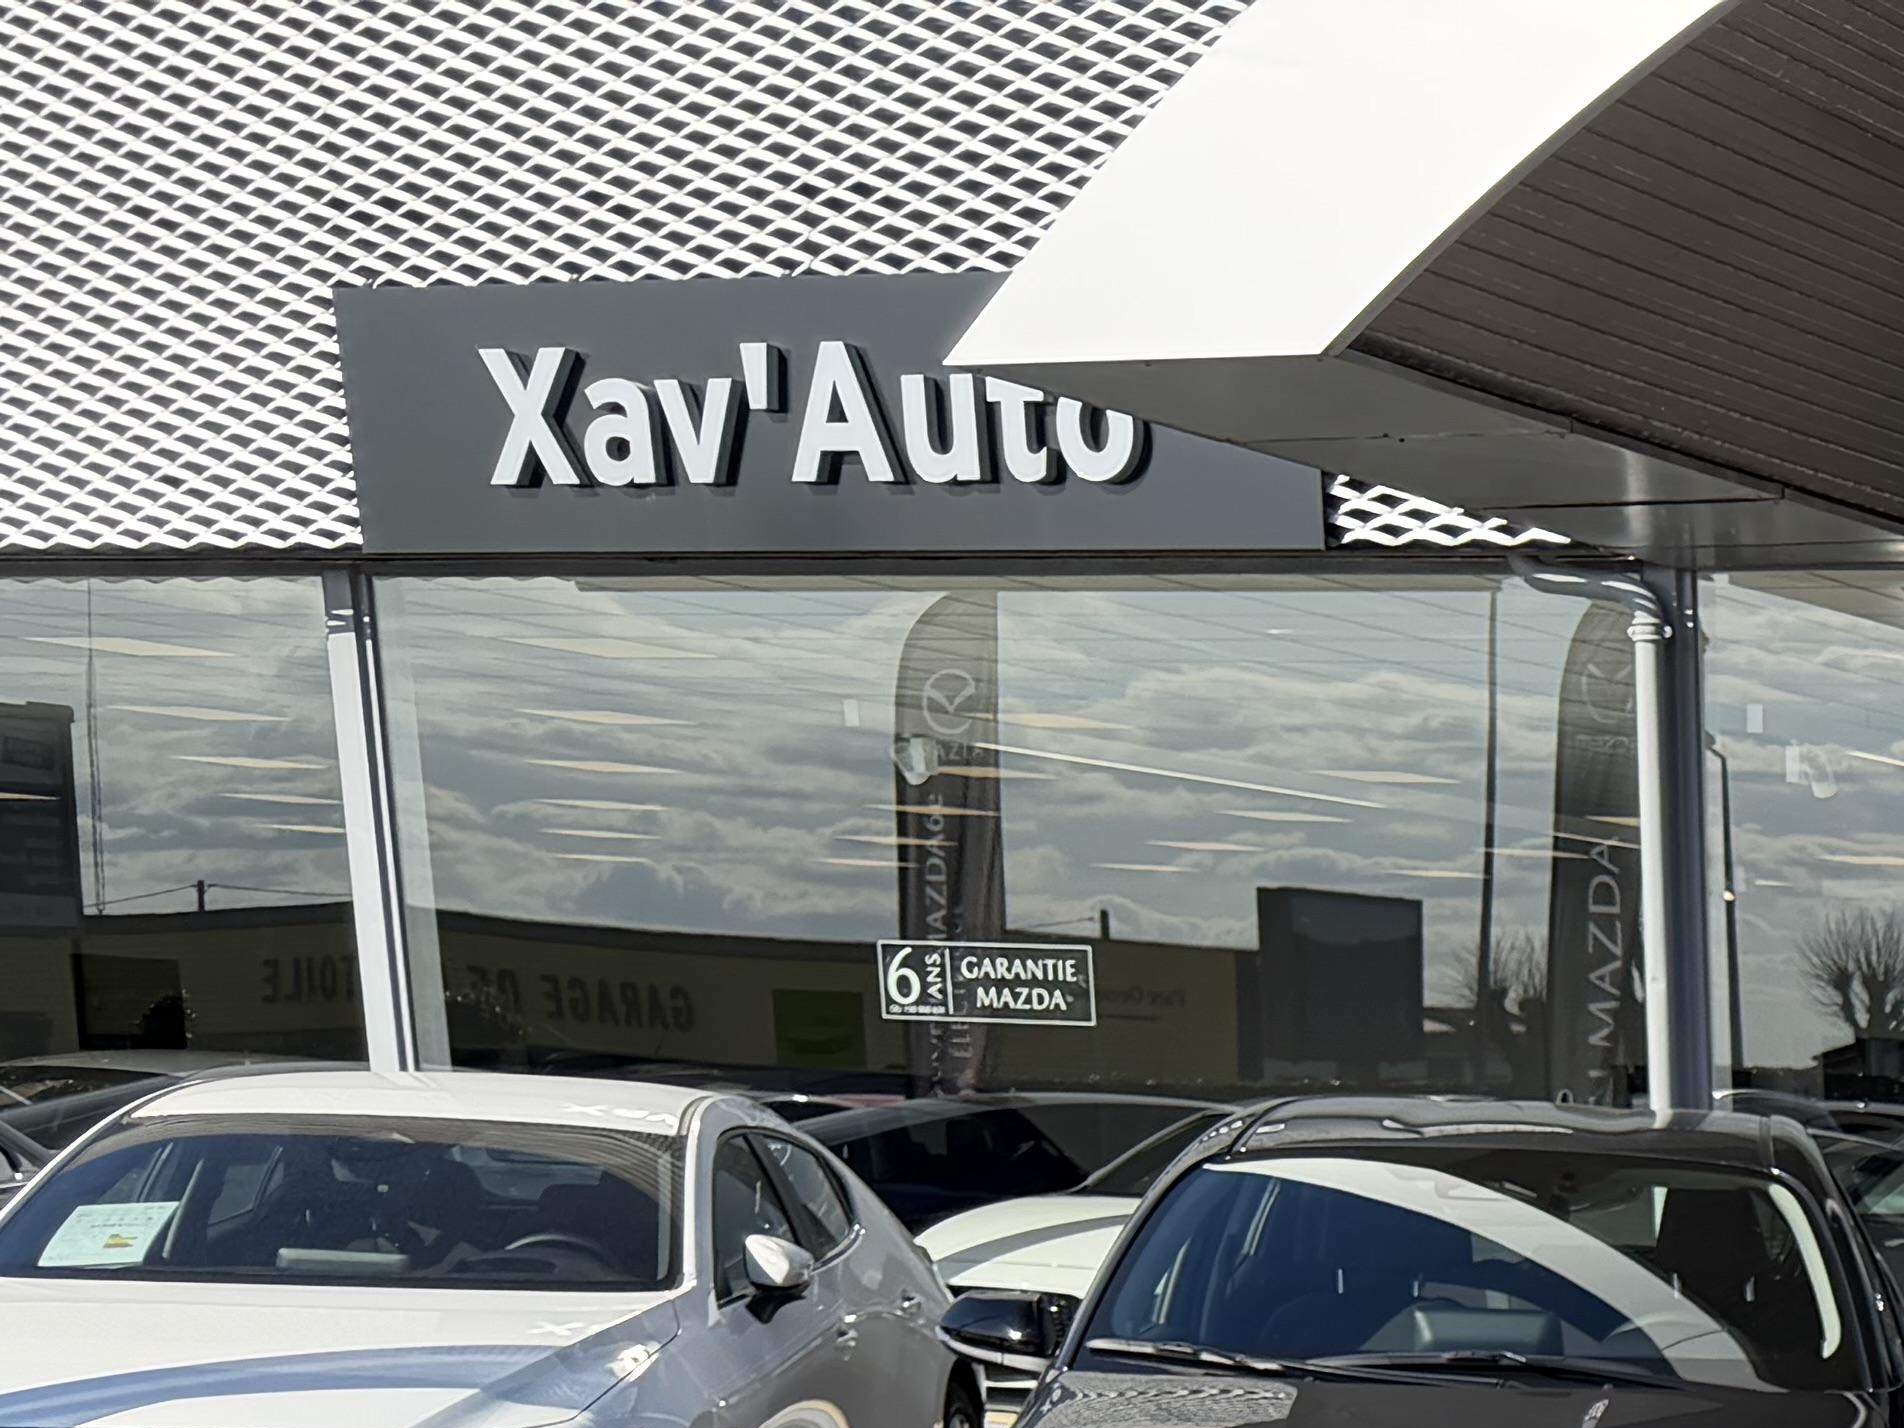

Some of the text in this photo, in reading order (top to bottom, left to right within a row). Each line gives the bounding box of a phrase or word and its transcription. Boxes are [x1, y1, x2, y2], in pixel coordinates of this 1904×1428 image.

[479, 341, 1138, 486] Xav'Auto
[1587, 836, 1623, 1048] MAZDA
[886, 946, 922, 1005] 6
[924, 953, 944, 1001] ANS
[960, 956, 1078, 983] GARANTIE
[976, 986, 1068, 1011] MAZDA
